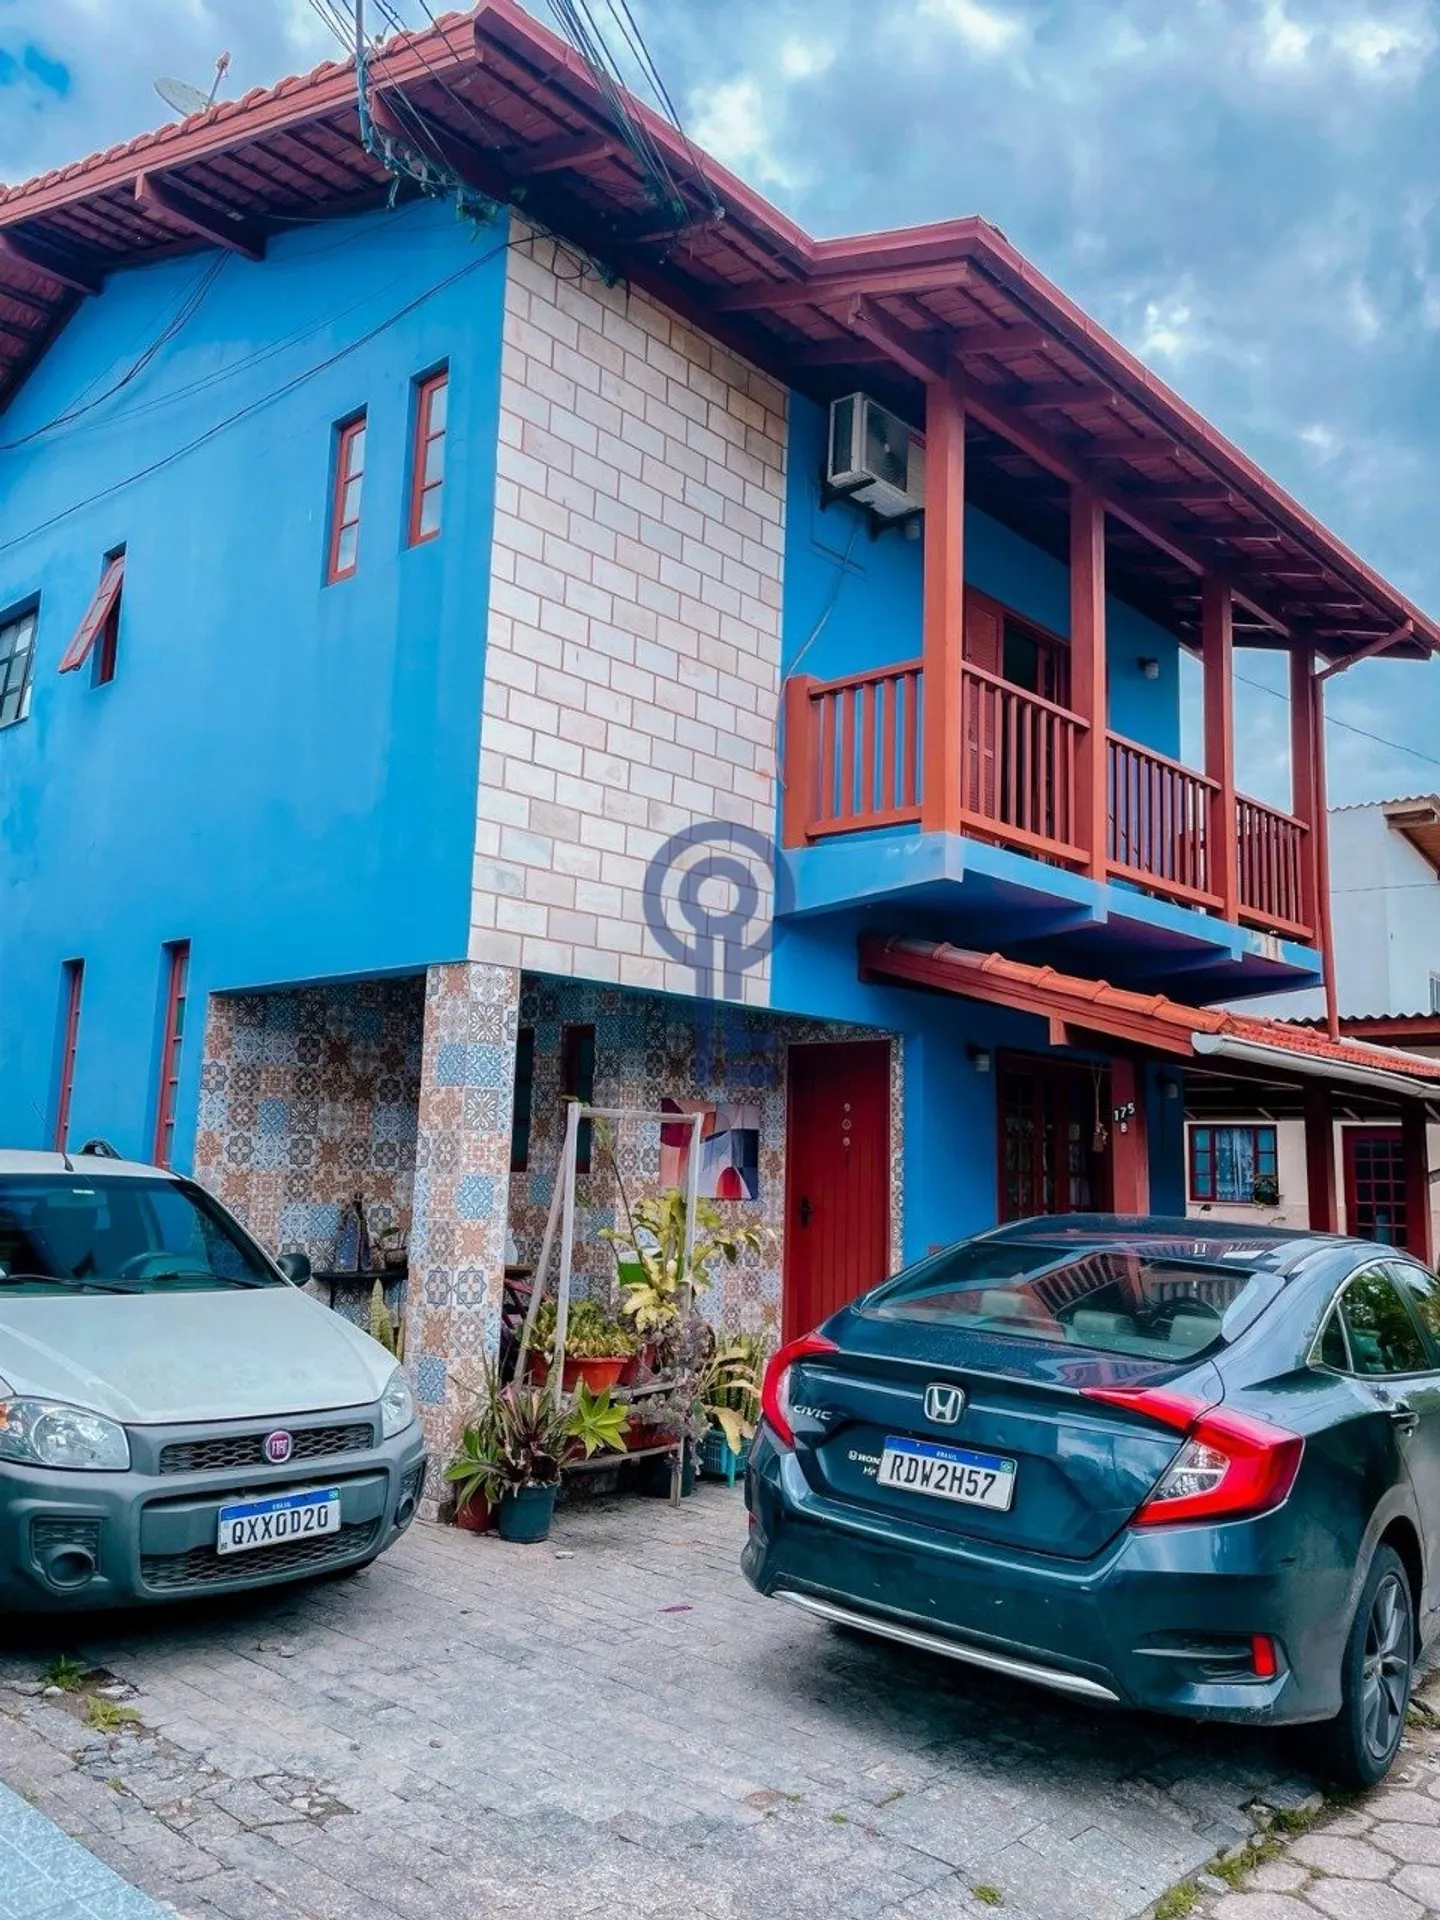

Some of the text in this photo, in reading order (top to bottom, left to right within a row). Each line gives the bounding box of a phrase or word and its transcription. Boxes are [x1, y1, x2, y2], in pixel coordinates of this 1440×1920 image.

[1114, 1102, 1135, 1121] 175
[793, 1404, 832, 1420] CIVIC
[272, 1439, 288, 1455] FIAT
[936, 1450, 958, 1460] BRASIL
[889, 1453, 996, 1499] RDW2H57
[232, 1505, 328, 1545] QXX0D20
